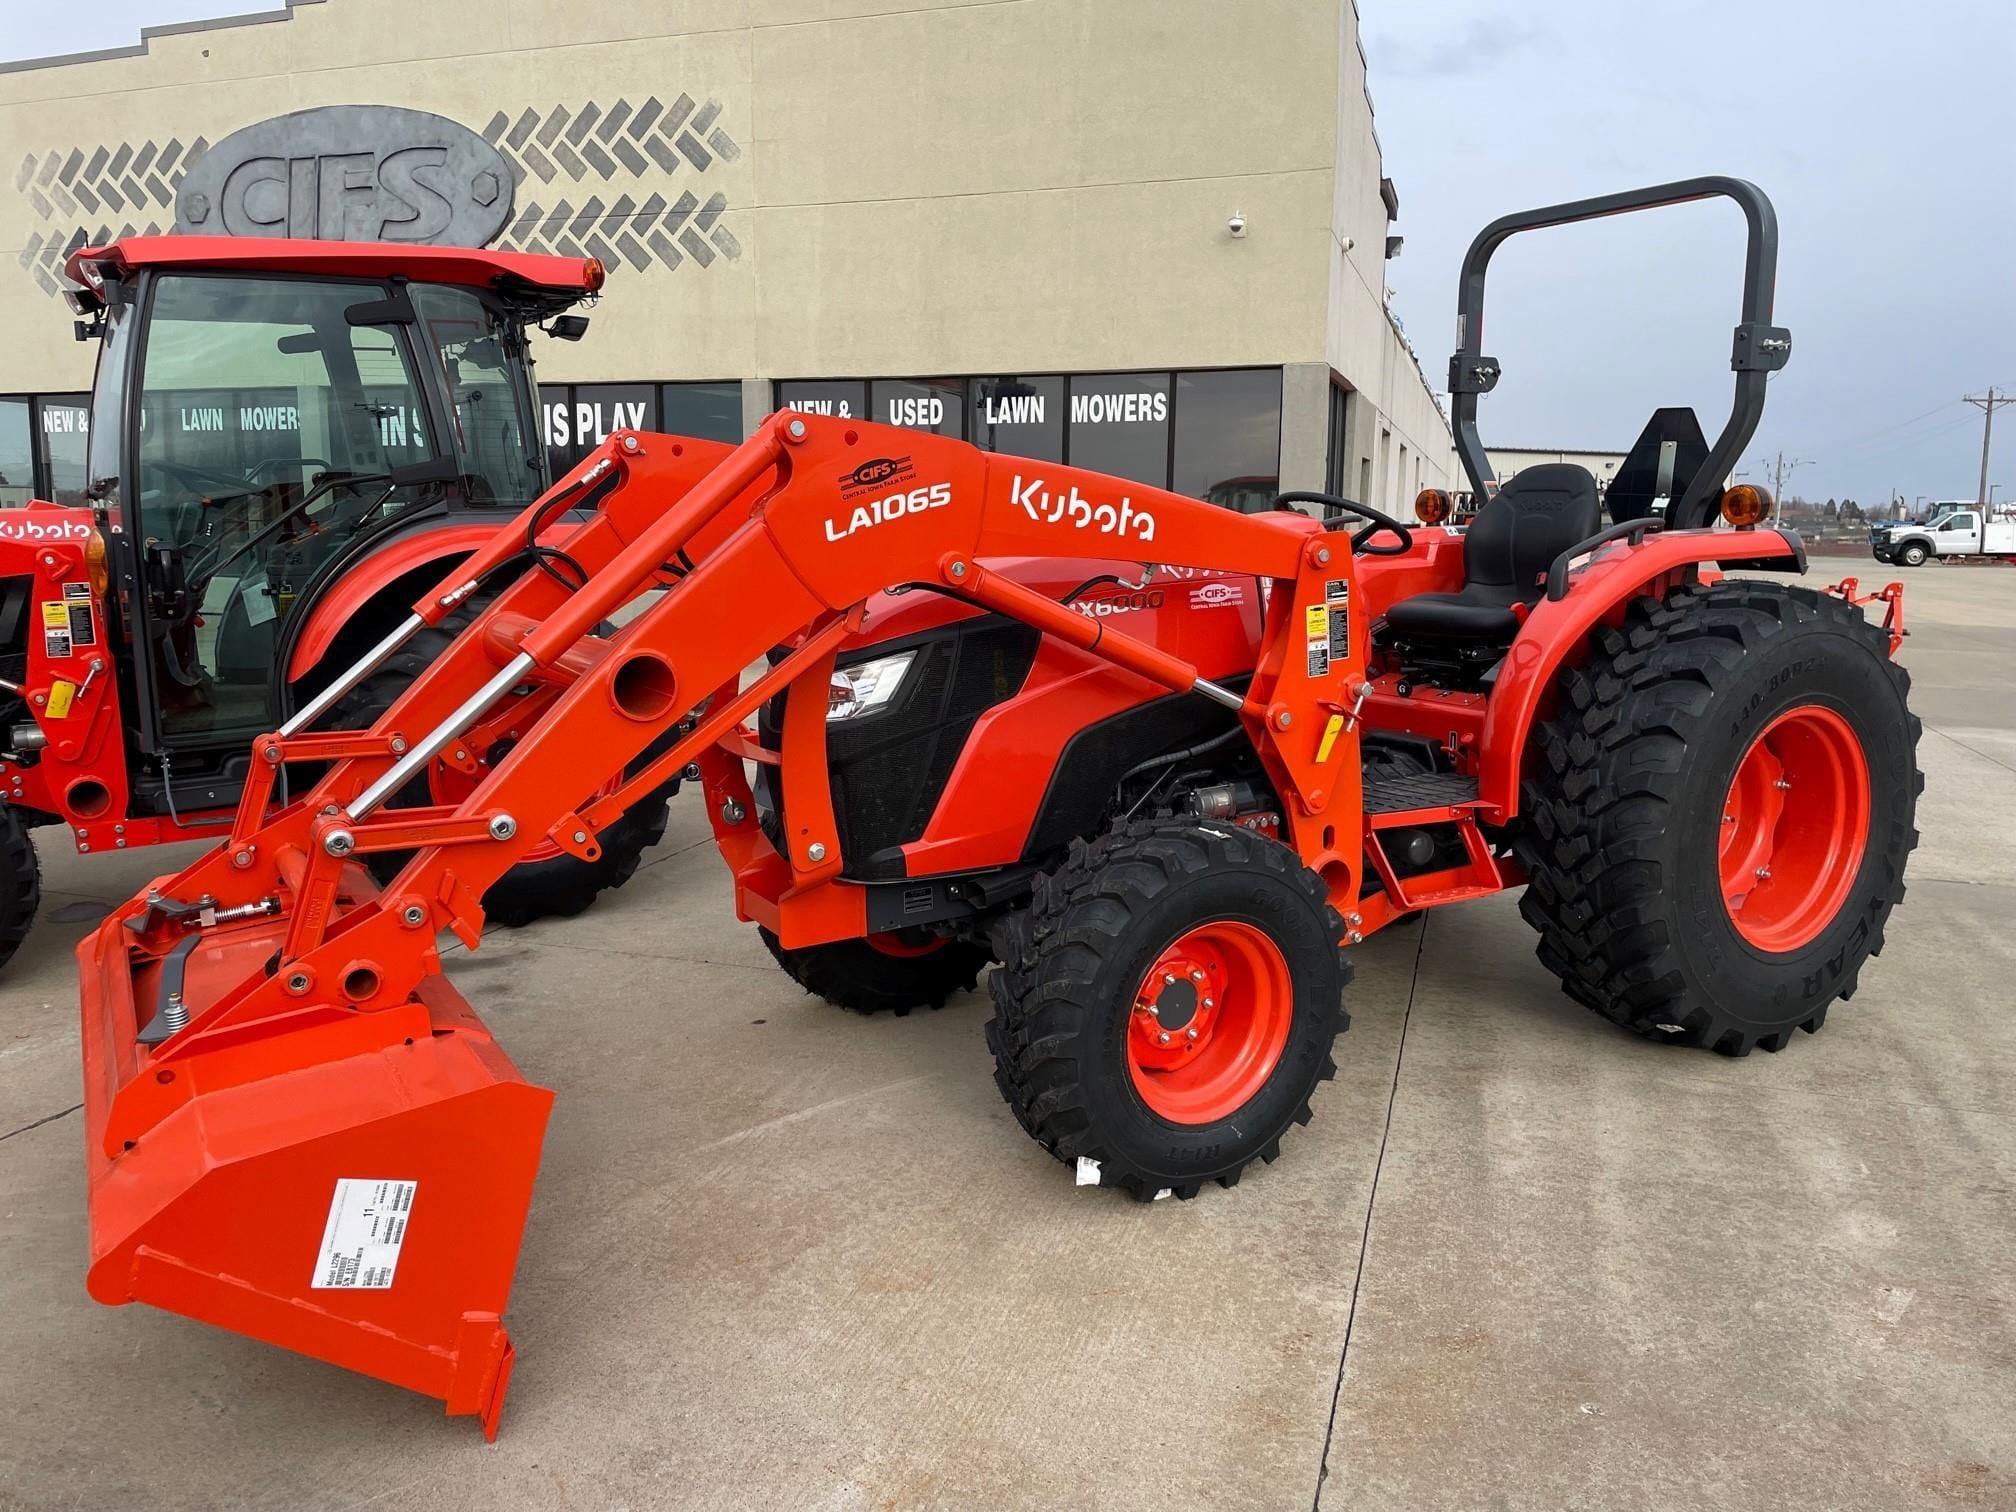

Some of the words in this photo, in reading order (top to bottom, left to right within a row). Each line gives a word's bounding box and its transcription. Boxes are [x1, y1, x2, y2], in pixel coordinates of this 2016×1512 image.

[221, 147, 453, 240] CIFS
[43, 410, 74, 433] NEW
[78, 409, 89, 432] &
[181, 408, 223, 431] LAWN
[240, 407, 300, 431] MOWER
[839, 400, 852, 419] &
[889, 398, 943, 426] USED
[986, 396, 1044, 425] LAWN
[1071, 393, 1167, 424] MOWERS
[859, 462, 892, 482] CIFS
[825, 482, 951, 542] LA1065
[1011, 475, 1155, 541] Kubota
[1204, 588, 1226, 599] CIFS
